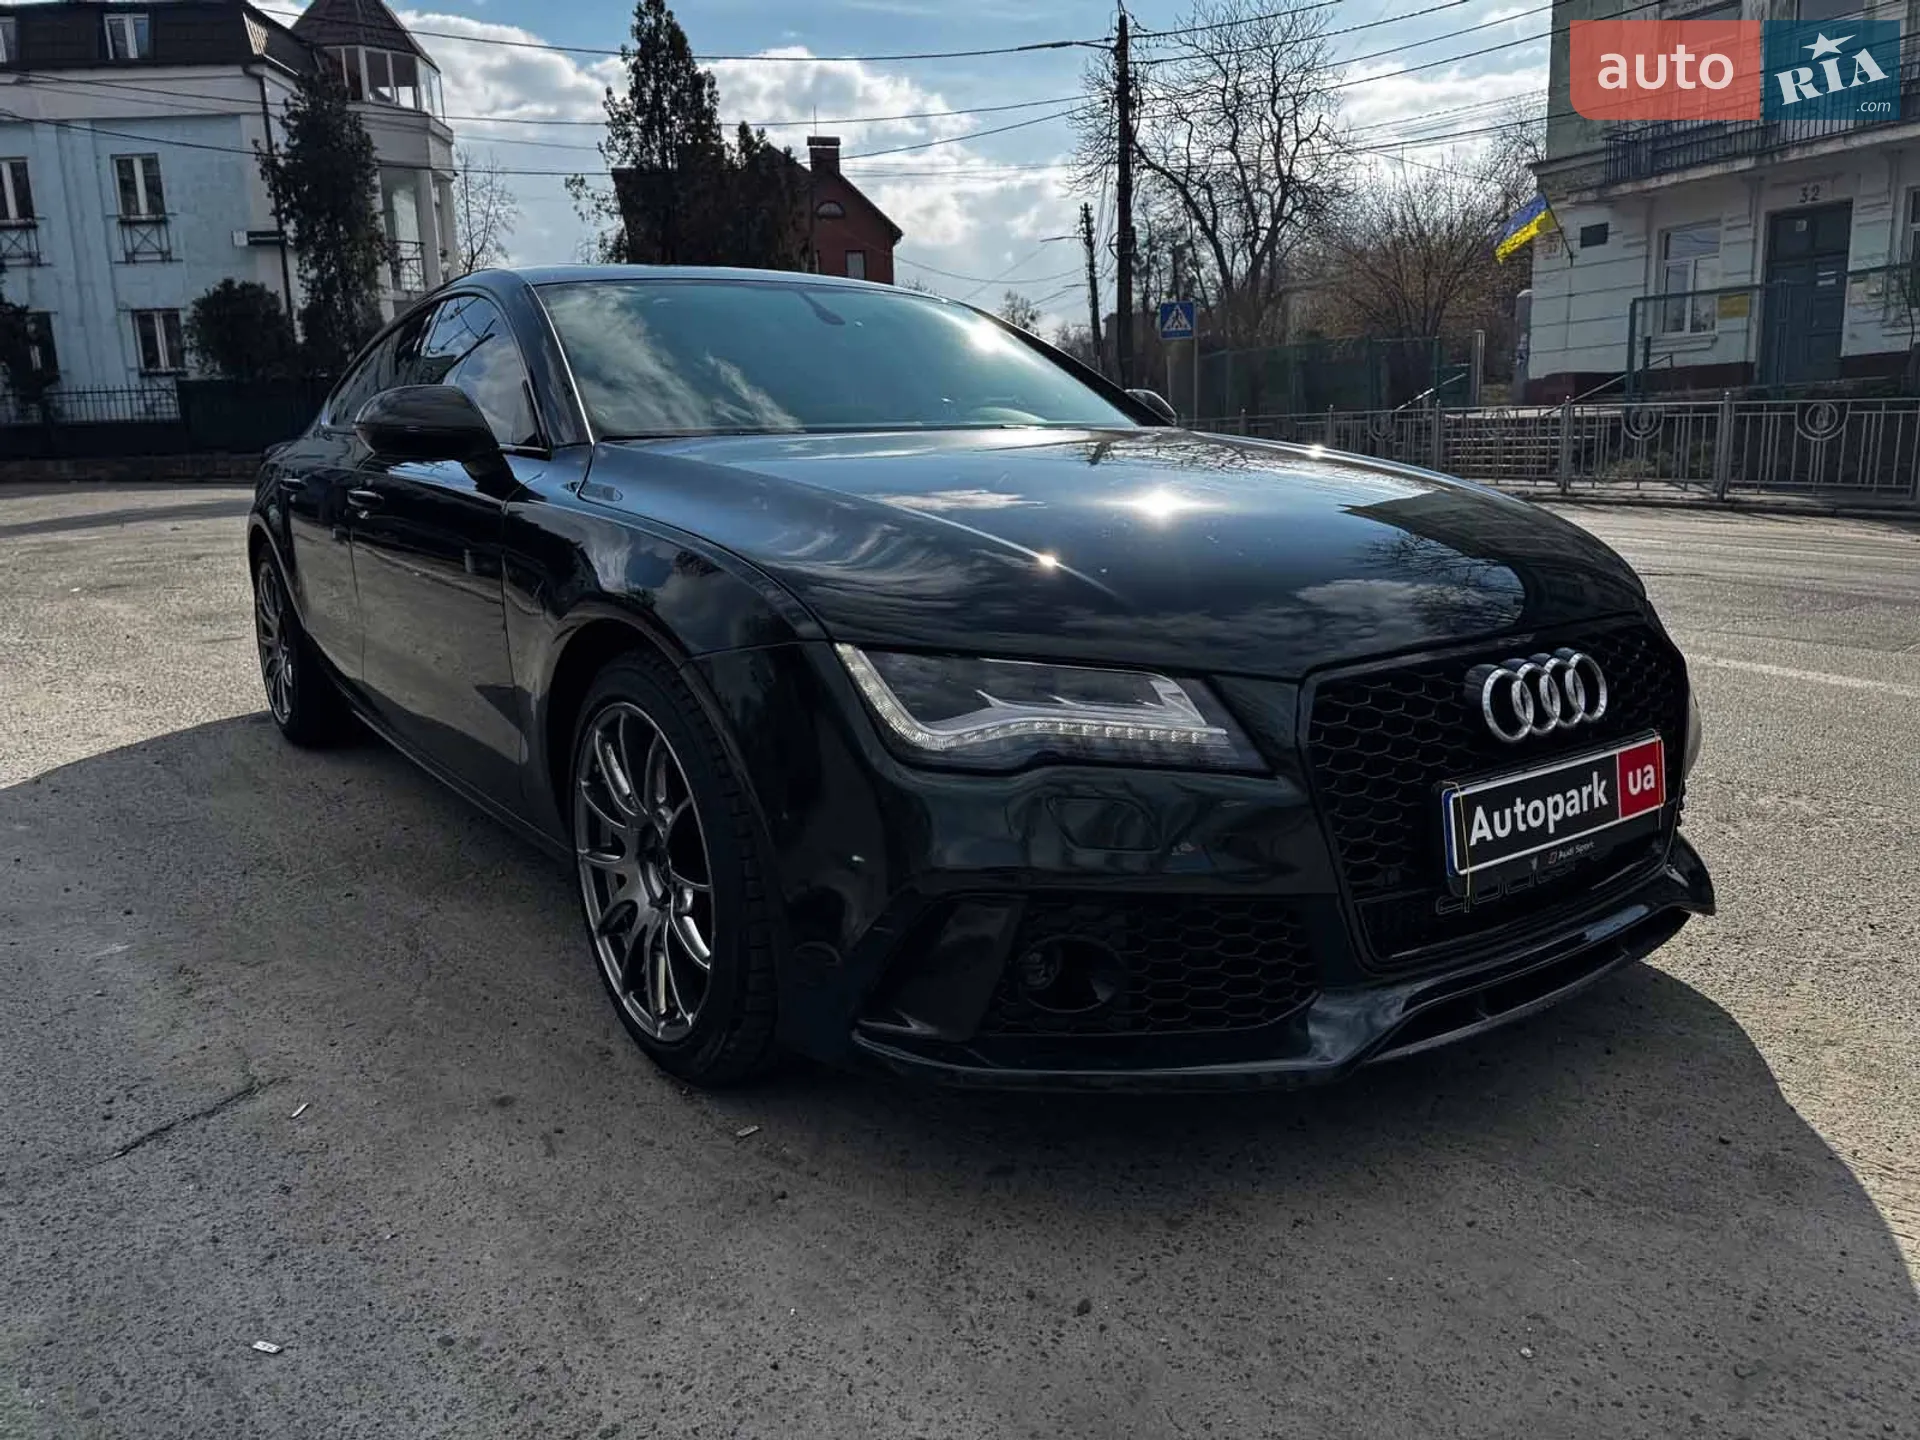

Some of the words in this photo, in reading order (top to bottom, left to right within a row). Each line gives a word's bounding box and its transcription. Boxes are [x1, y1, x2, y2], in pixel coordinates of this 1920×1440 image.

[1469, 771, 1609, 846] Autopark
[1627, 763, 1656, 796] ua
[1557, 845, 1574, 860] Audi
[1575, 840, 1595, 857] Sport
